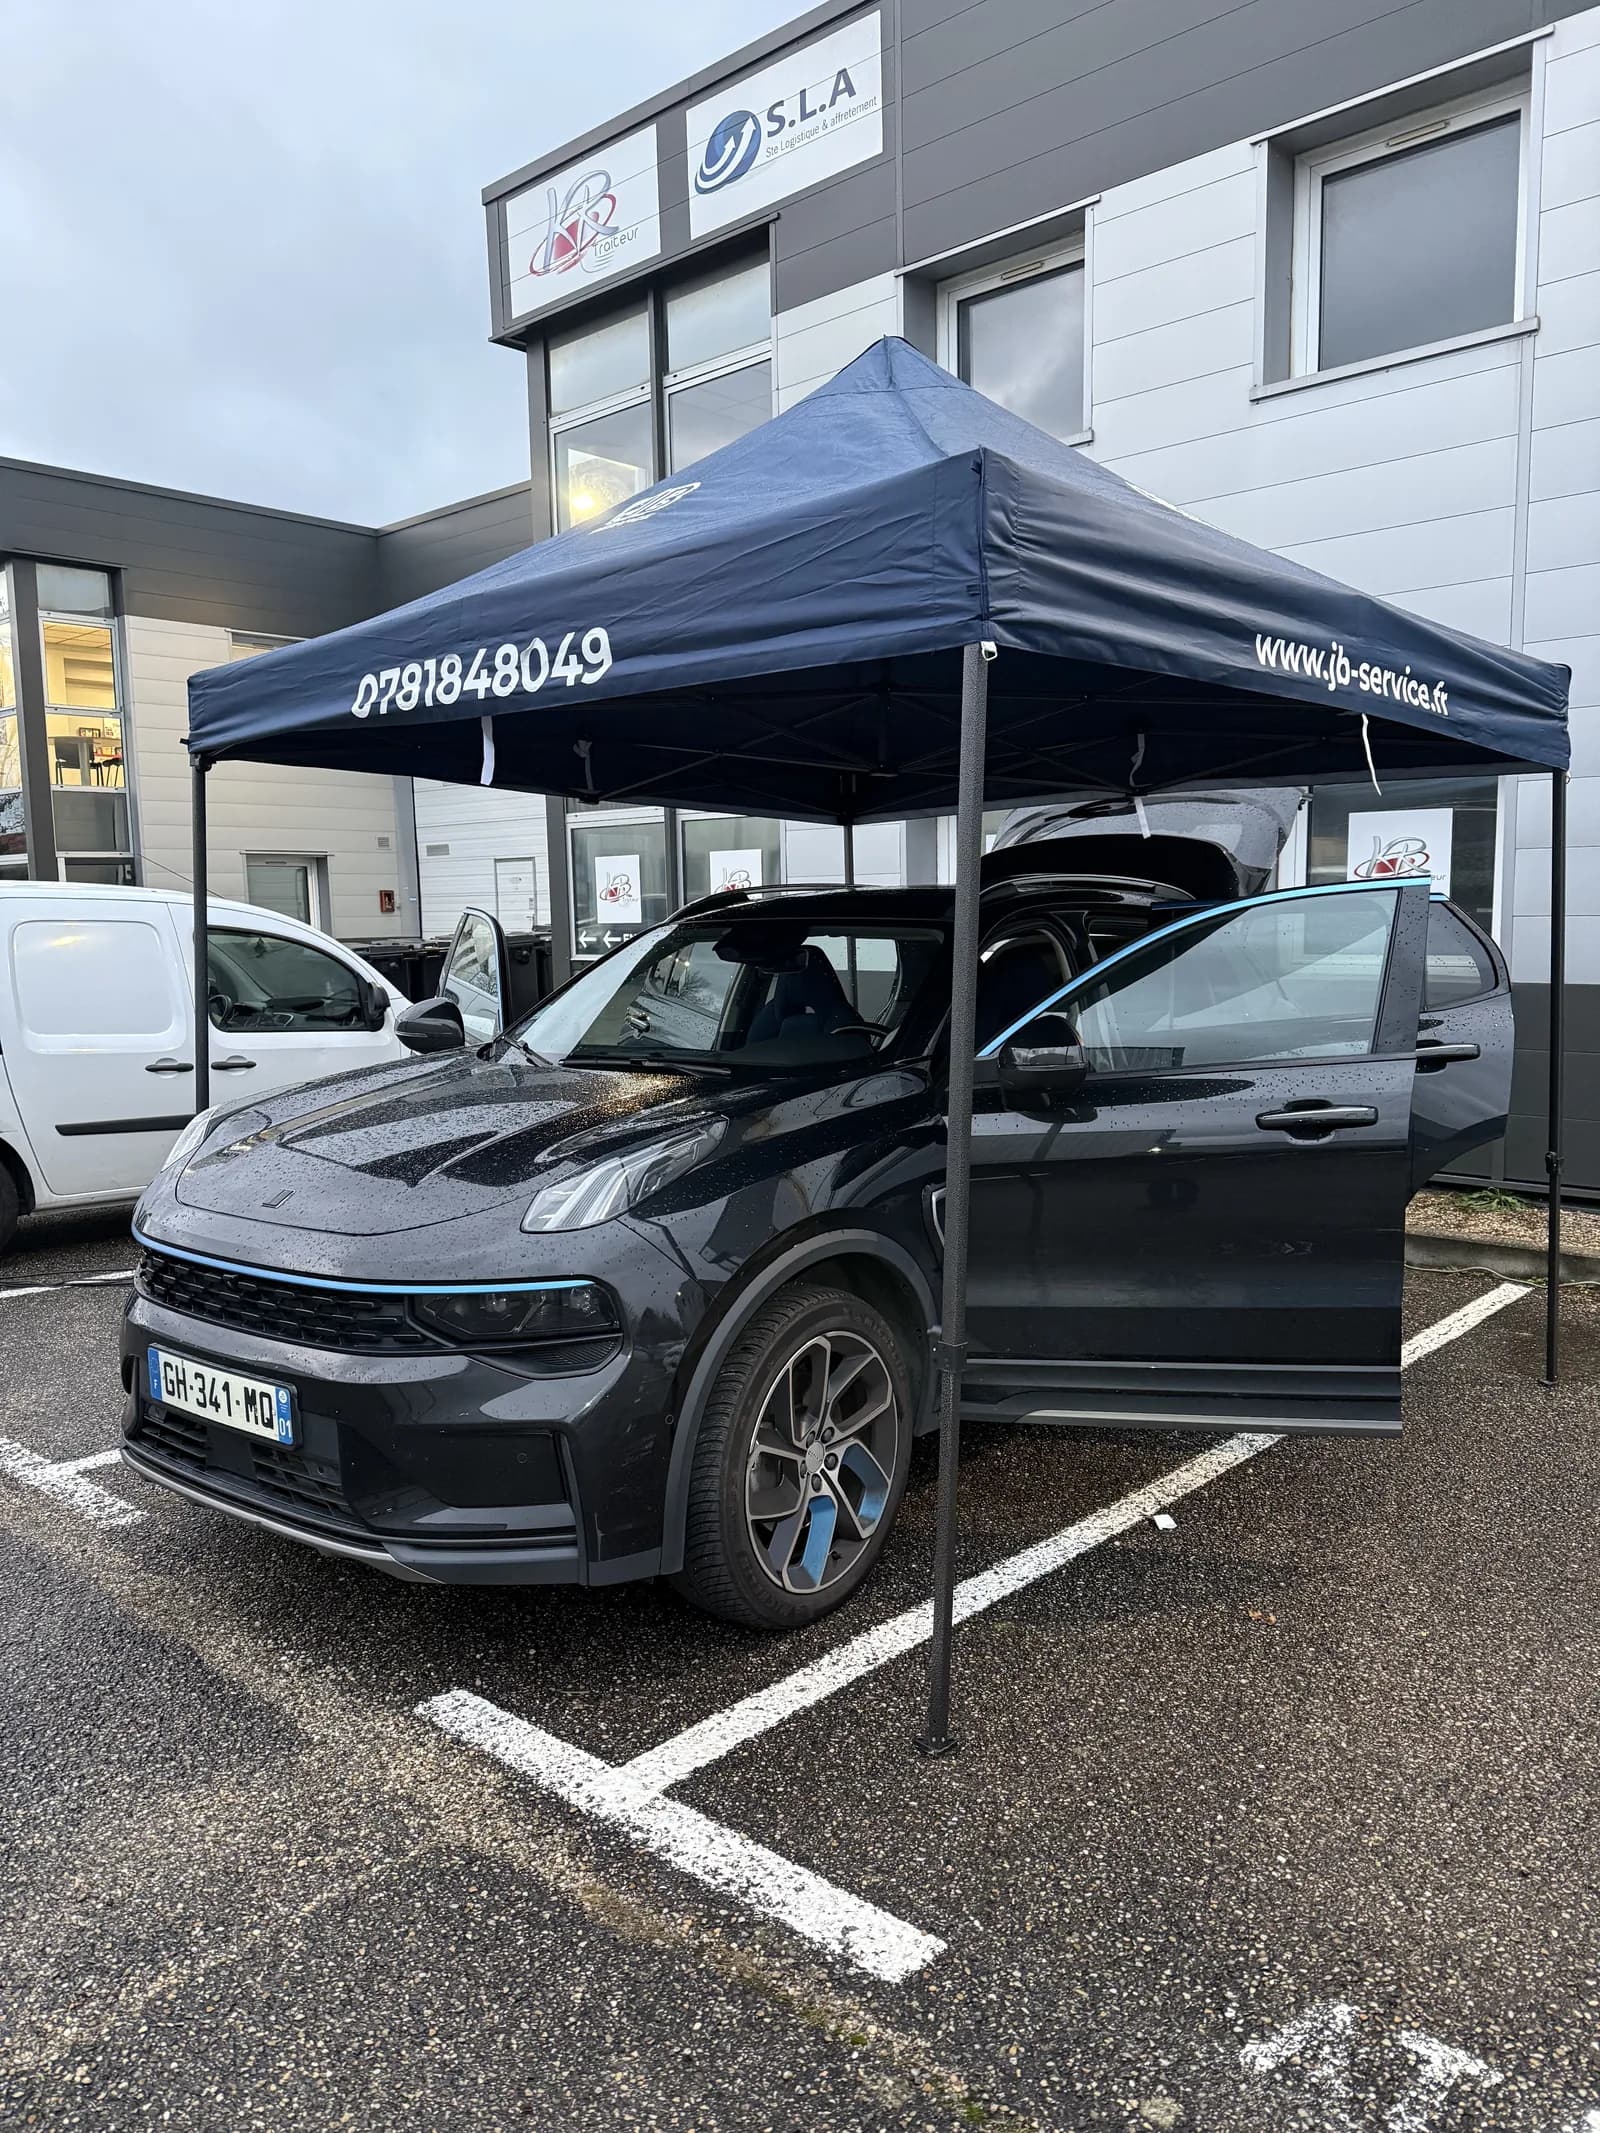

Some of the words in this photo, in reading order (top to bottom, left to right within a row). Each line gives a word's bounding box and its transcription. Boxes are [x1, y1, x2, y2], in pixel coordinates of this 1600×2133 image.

[765, 145, 779, 158] Ste
[780, 124, 820, 149] Logistique
[821, 119, 828, 131] &
[830, 96, 878, 127] affretement
[766, 67, 857, 138] S.L.A
[591, 227, 639, 257] Traiteur
[351, 626, 613, 719] 0781848049
[1255, 633, 1449, 716] www.jb-service.fr
[163, 1360, 275, 1430] GH-341-MQ
[278, 1419, 292, 1438] 01
